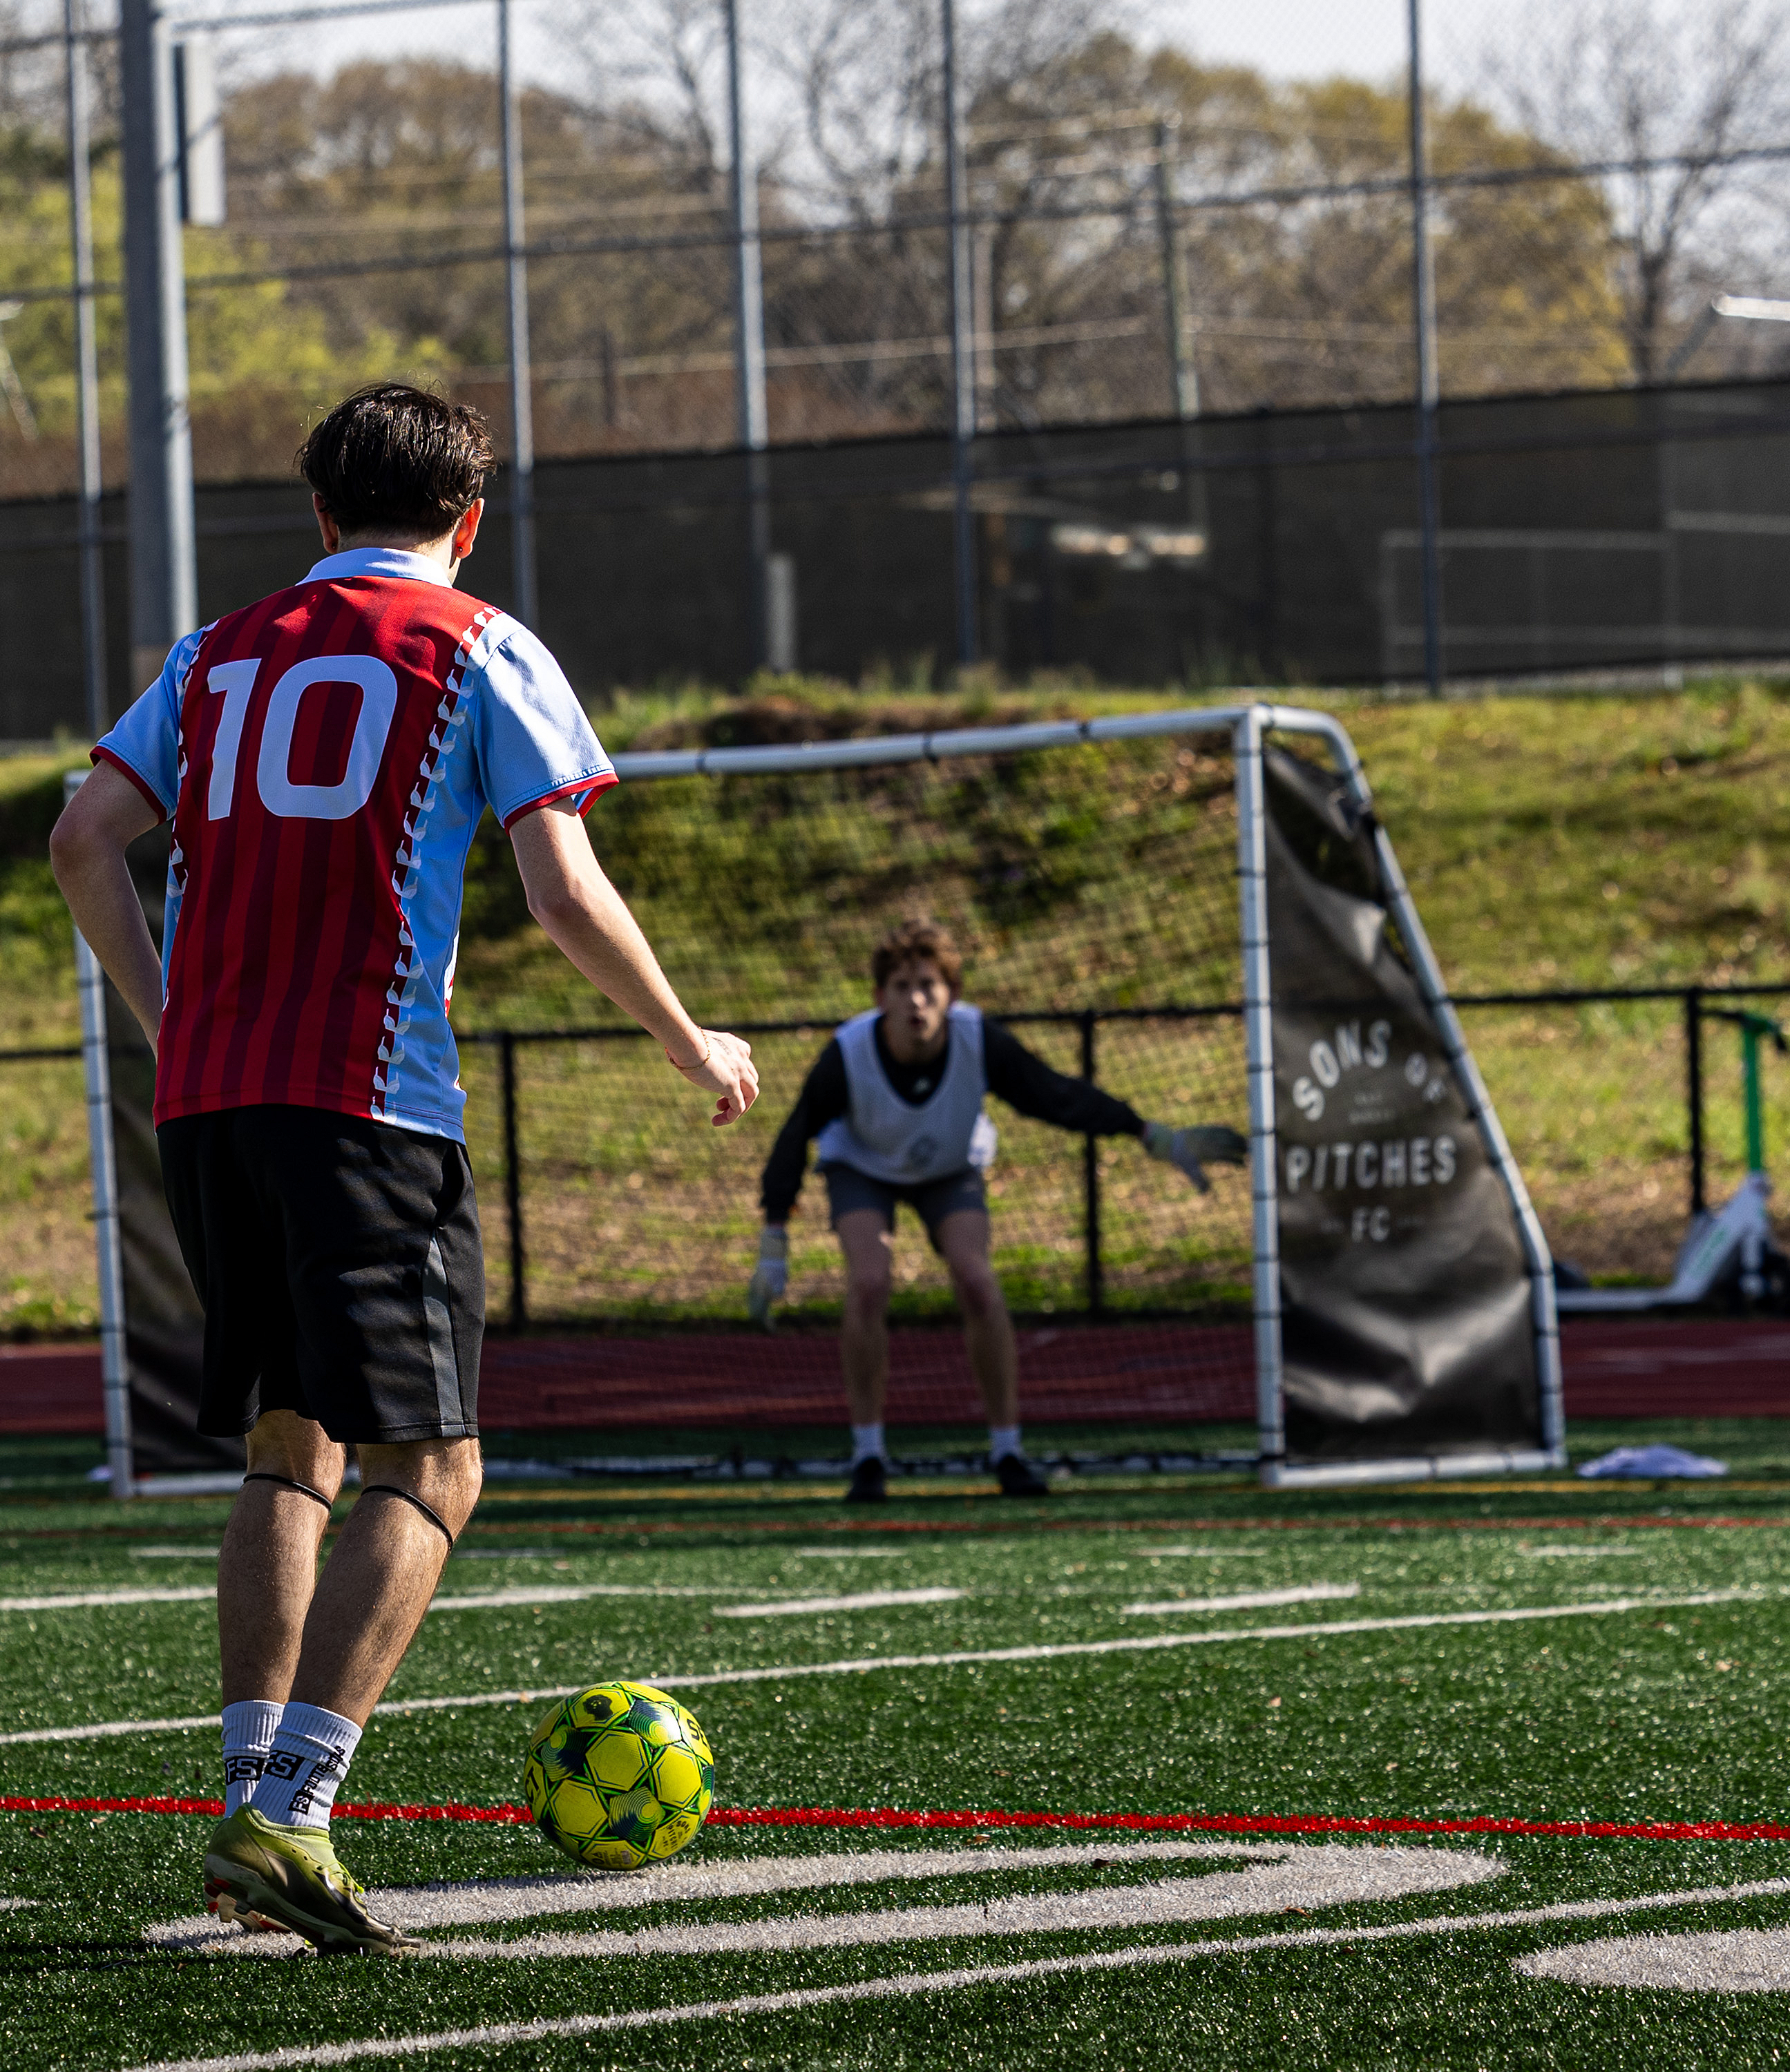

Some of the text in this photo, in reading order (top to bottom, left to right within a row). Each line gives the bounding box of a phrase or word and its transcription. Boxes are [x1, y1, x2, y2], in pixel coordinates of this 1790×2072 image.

[208, 655, 398, 821] 10
[1292, 1018, 1391, 1122] SONS
[1286, 1135, 1456, 1193] PITCHES
[1351, 1206, 1390, 1242] FC
[226, 1758, 258, 1783] FS
[292, 1795, 310, 1812] FS
